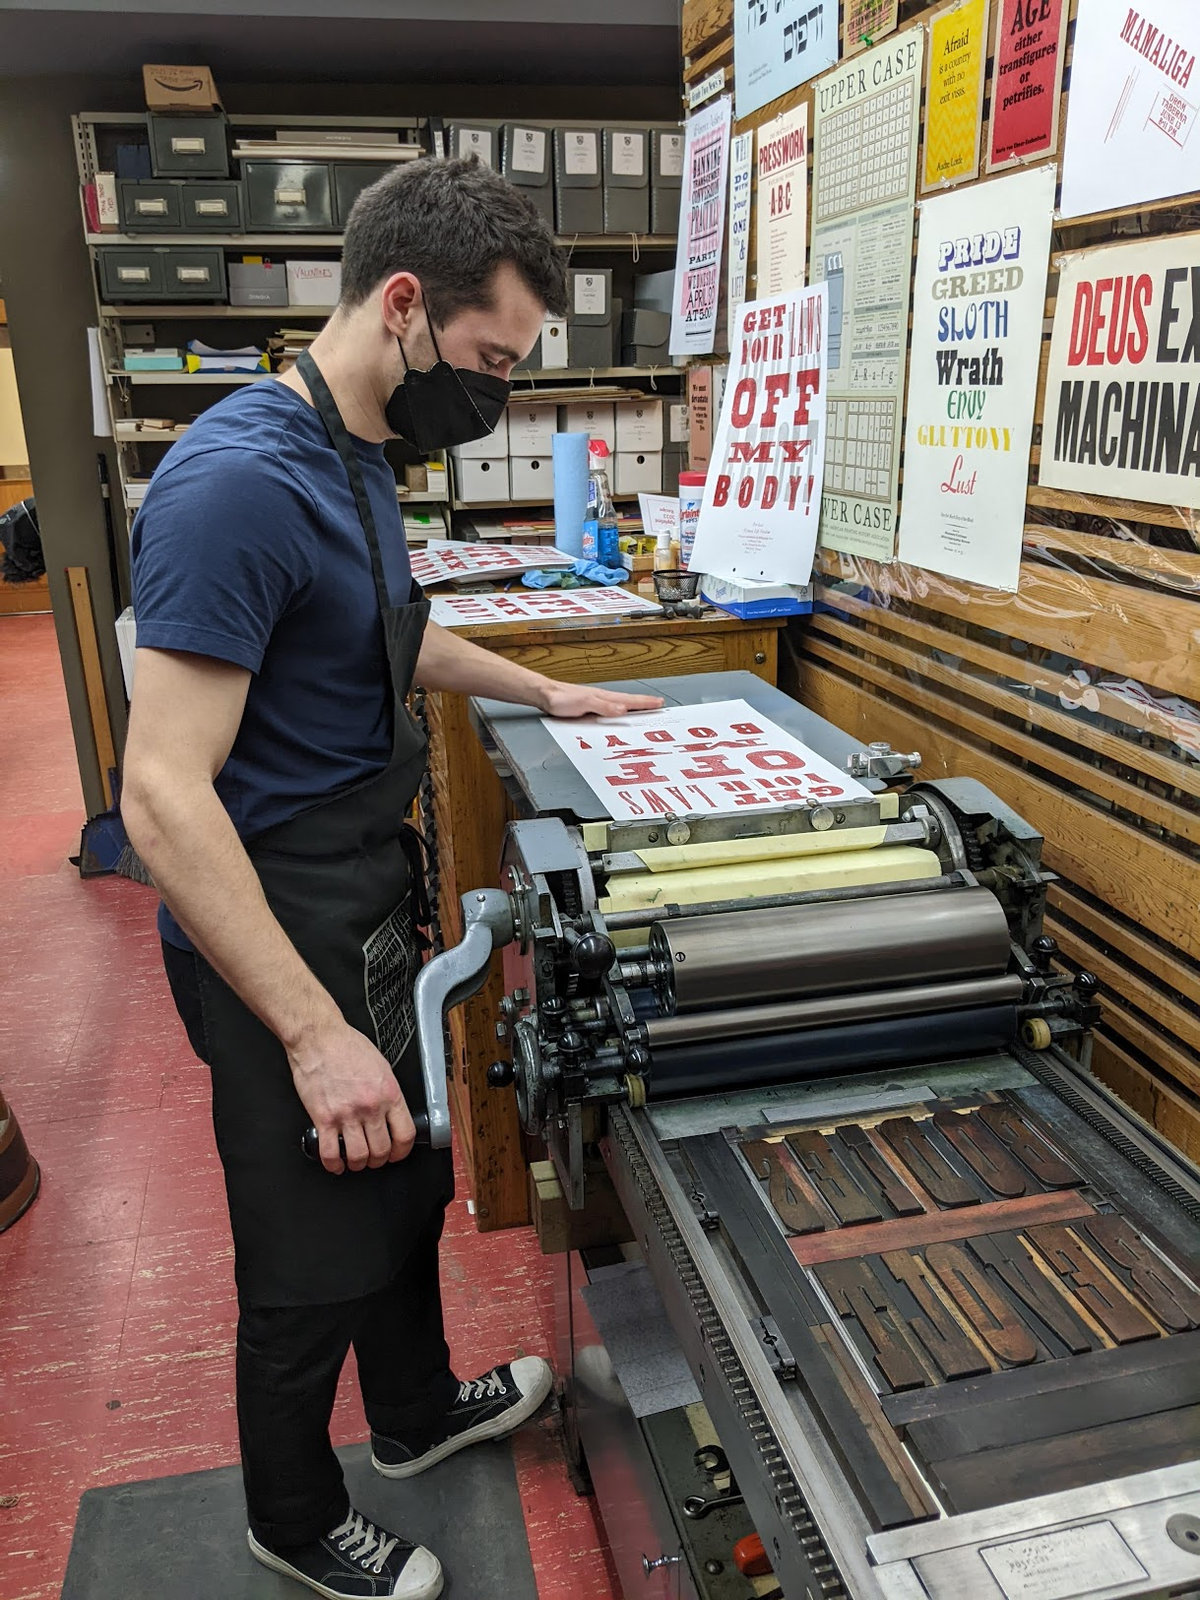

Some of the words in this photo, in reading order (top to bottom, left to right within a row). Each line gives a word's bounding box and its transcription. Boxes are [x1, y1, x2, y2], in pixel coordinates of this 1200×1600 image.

[1010, 0, 1051, 35] AGE
[944, 28, 970, 55] Afraid
[1014, 30, 1043, 52] either
[1120, 8, 1195, 88] MAMALIGA
[948, 52, 972, 71] country
[1000, 42, 1056, 76] transfigures
[819, 68, 866, 113] UPPER
[872, 41, 917, 86] CASE
[943, 74, 956, 87] with
[956, 71, 965, 82] no
[1019, 70, 1030, 84] or
[940, 91, 951, 104] exit
[1003, 84, 1044, 111] petrifies.
[1160, 108, 1176, 123] JUNE
[693, 146, 721, 179] BANNING
[759, 126, 805, 176] PRESSWORK
[734, 172, 748, 184] DO
[734, 200, 747, 211] your
[733, 219, 747, 235] ONE
[689, 250, 717, 264] PARTY
[938, 226, 1021, 272] PRIDE
[688, 268, 716, 290] WEDNESDAY
[931, 265, 1024, 301] GREED
[686, 288, 707, 310] APRIL
[685, 309, 699, 322] AT
[743, 304, 786, 333] GET
[790, 295, 822, 357] LAWS
[937, 300, 1008, 342] SLOTH
[1067, 274, 1153, 366] DEUS
[741, 333, 783, 365] YOUR
[936, 348, 1003, 386] Wrath
[731, 368, 820, 429] OFF
[917, 424, 1015, 452] GLUTTONY
[1054, 381, 1200, 477] MACHINA
[728, 440, 811, 463] MY
[941, 454, 977, 495] Lust
[712, 474, 814, 516] BODY!
[854, 504, 892, 532] CASE
[436, 550, 469, 571] MY
[463, 546, 523, 567] OFF
[445, 598, 502, 622] BODY!
[487, 597, 531, 617] MY
[517, 593, 592, 614] OFF
[575, 722, 765, 750] BODY!
[603, 737, 769, 761] MY
[604, 750, 806, 787] OFF
[717, 772, 829, 793] YOUR
[734, 784, 846, 807] GET
[617, 784, 718, 816] LAWS
